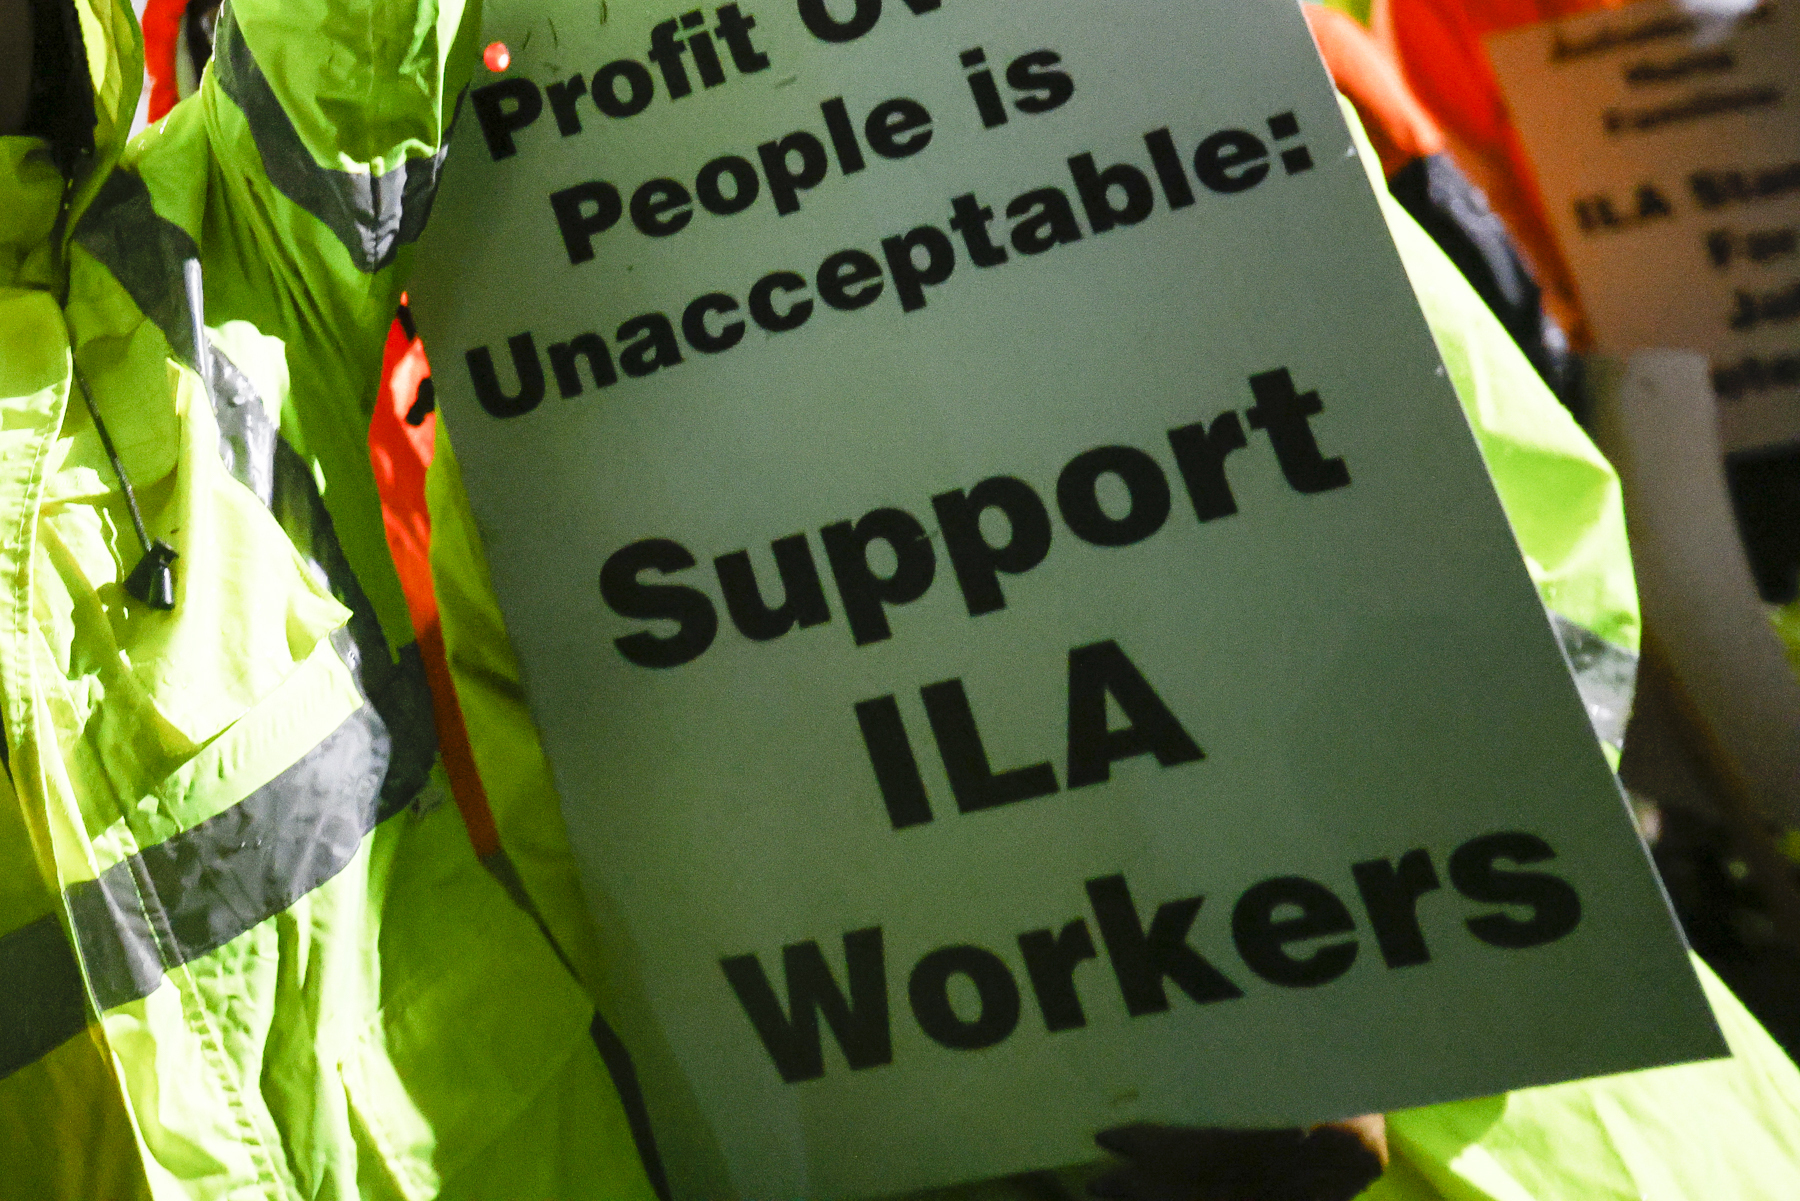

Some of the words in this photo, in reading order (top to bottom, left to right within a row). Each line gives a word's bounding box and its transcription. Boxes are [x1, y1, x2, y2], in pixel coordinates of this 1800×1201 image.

[470, 3, 770, 161] Profit
[550, 97, 933, 264] People
[960, 48, 1075, 130] is
[466, 111, 1314, 420] Unacceptable:
[599, 367, 1351, 670] Support
[854, 639, 1205, 830] ILA
[720, 831, 1582, 1084] Workers
